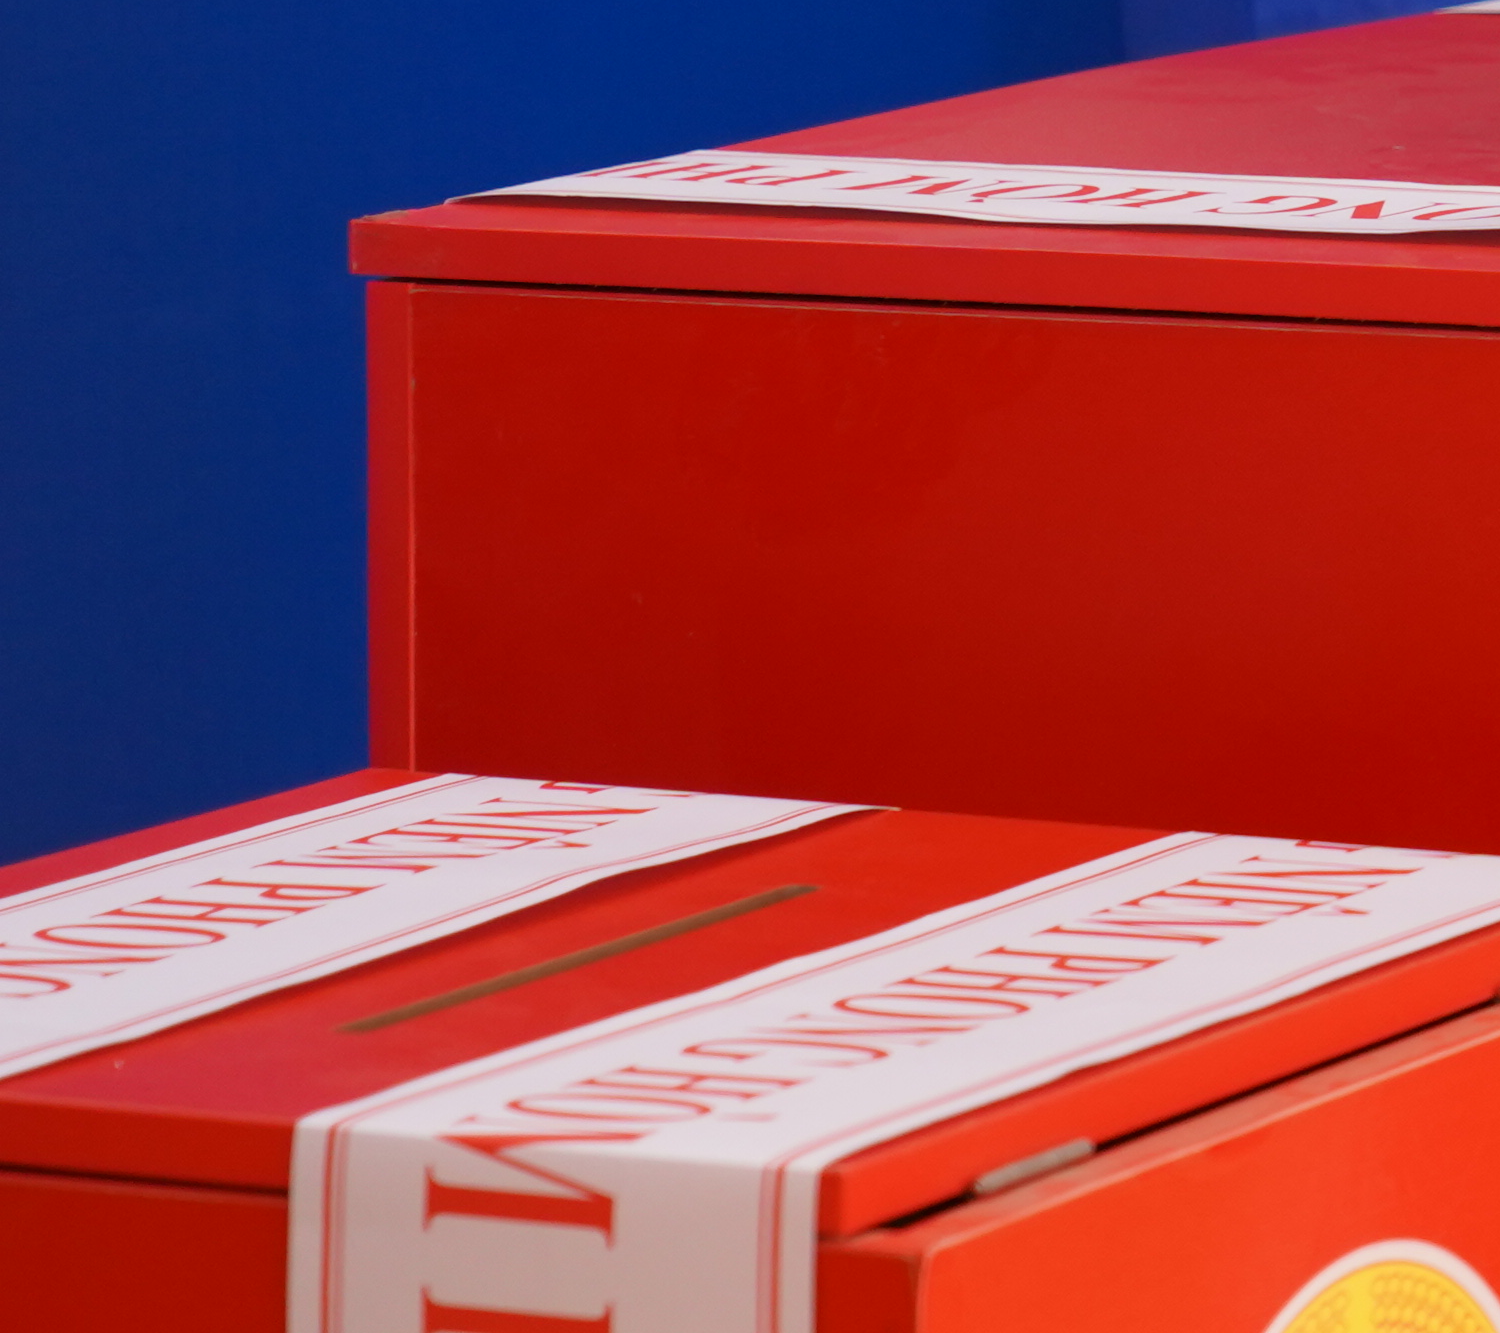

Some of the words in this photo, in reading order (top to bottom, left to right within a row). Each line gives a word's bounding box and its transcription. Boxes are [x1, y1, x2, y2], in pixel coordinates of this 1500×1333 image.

[824, 174, 1226, 210] HÒM
[252, 797, 658, 875] NIÊM
[1030, 855, 1423, 947] NIÊM
[681, 945, 1178, 1070] PHONG
